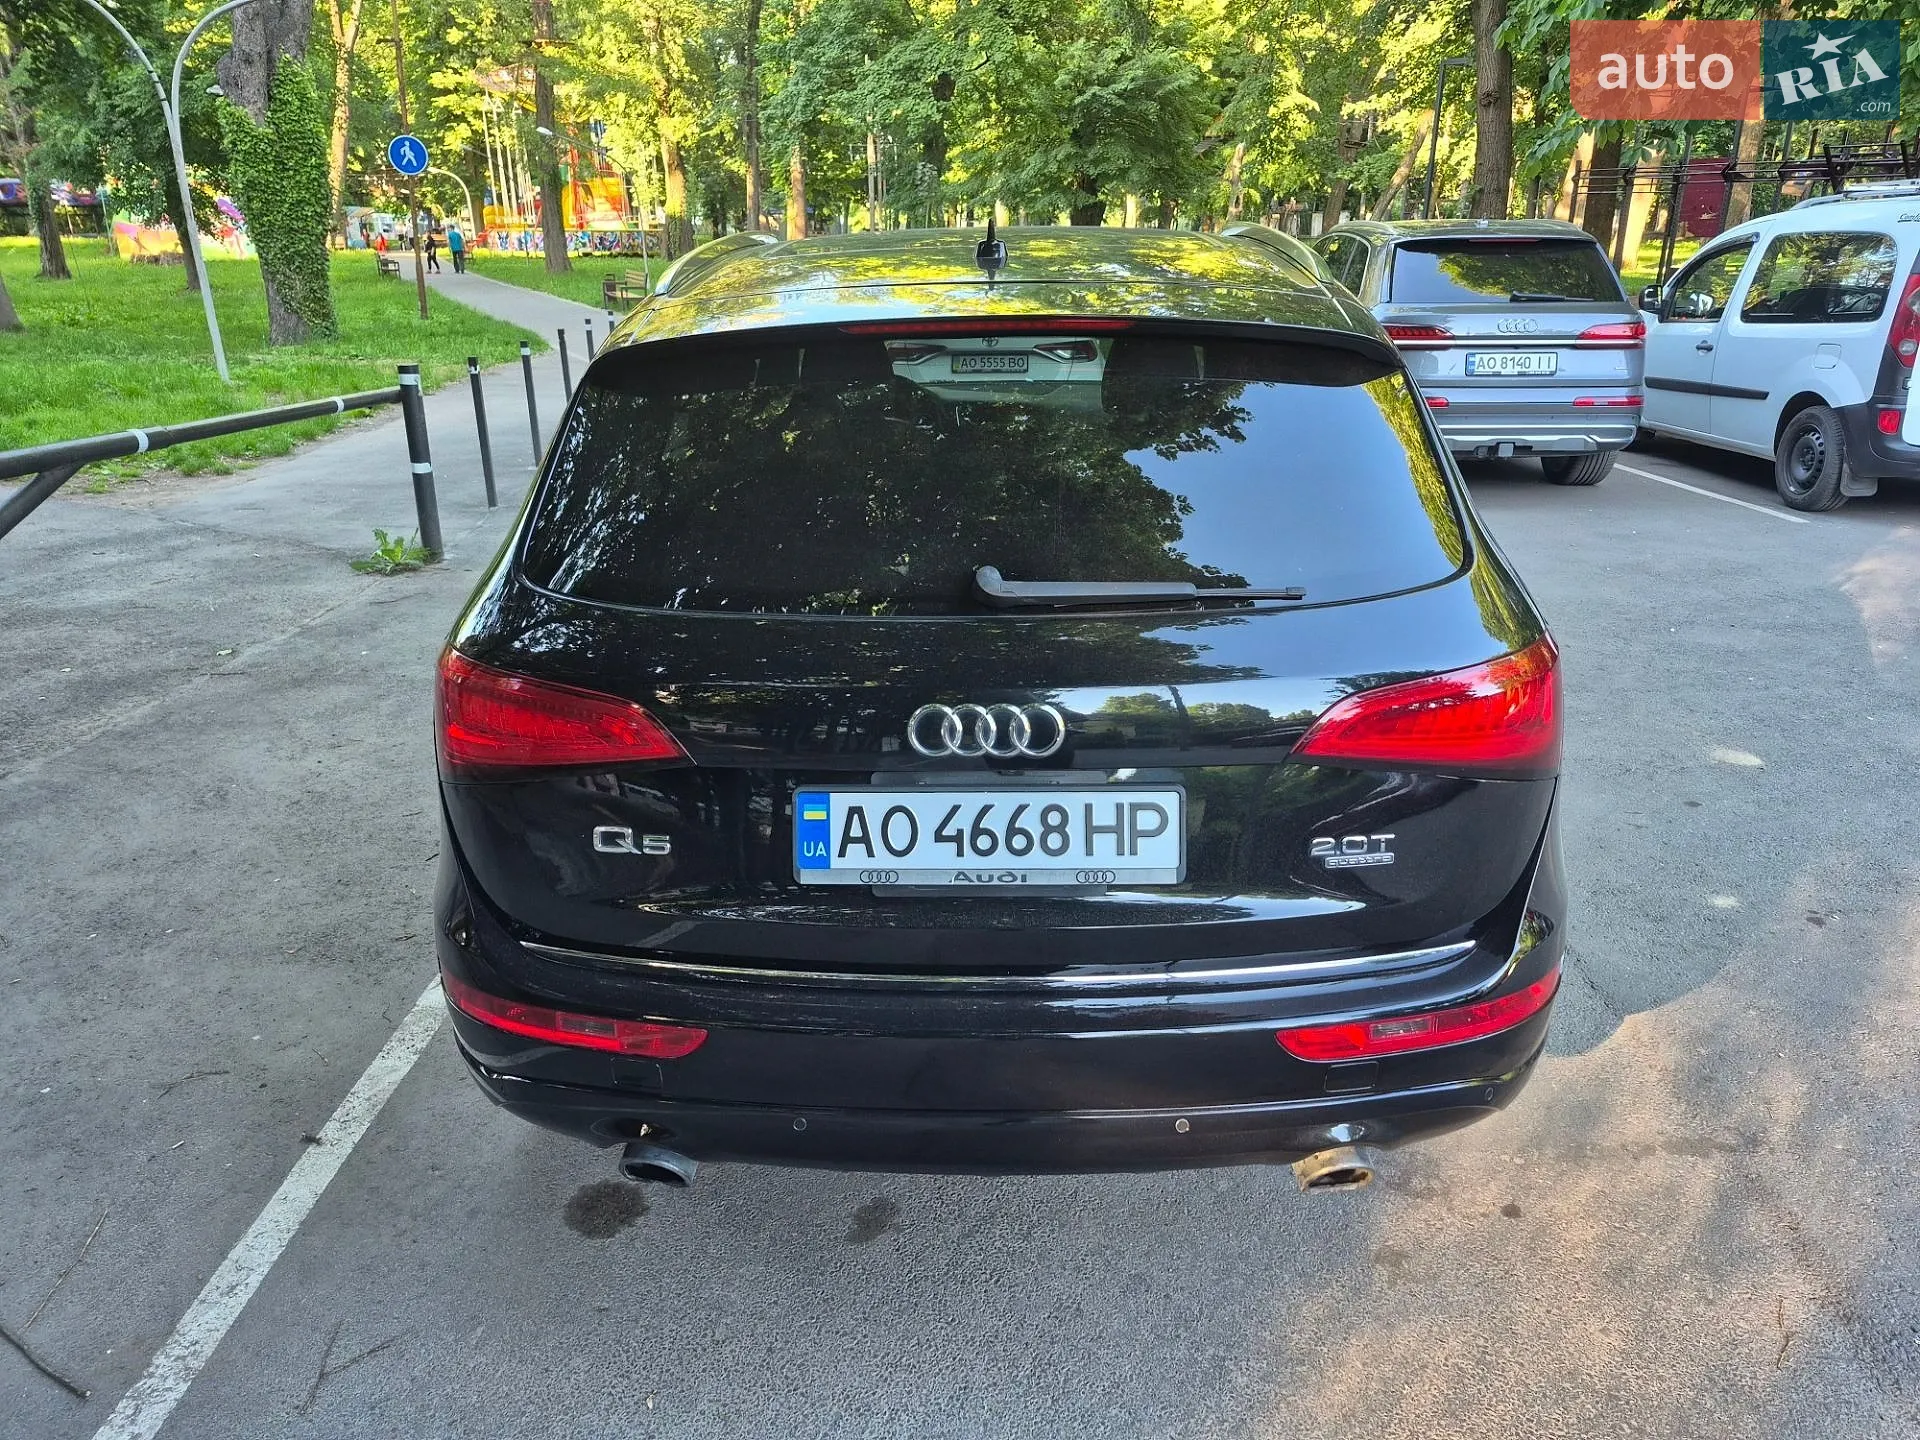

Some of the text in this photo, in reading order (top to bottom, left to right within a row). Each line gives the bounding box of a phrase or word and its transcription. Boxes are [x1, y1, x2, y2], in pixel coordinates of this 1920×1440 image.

[960, 357, 1025, 369] AO 5555 BO
[1476, 356, 1497, 370] AO
[1500, 356, 1531, 370] 8140
[837, 801, 1170, 859] AO 4668 HP
[592, 825, 672, 855] Q5
[803, 841, 827, 857] UA
[948, 870, 1027, 884] Audi
